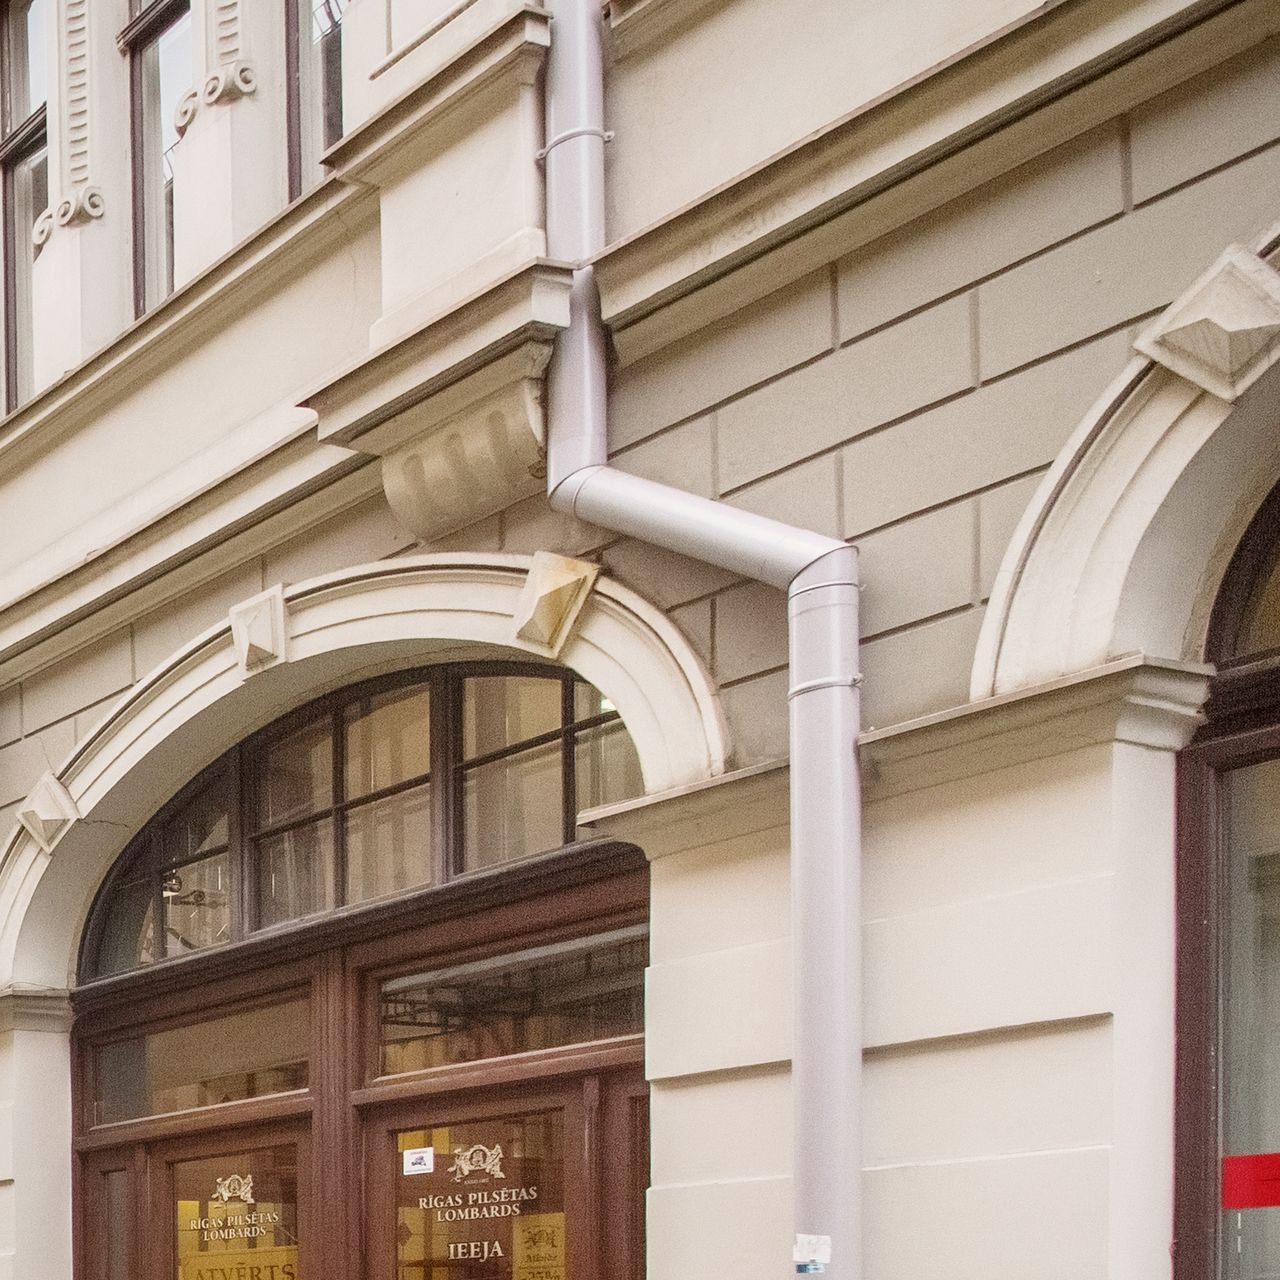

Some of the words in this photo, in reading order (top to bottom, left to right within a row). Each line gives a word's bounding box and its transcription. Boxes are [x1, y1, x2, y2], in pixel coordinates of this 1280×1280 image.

[418, 1194, 463, 1209] RĪGAS
[468, 1186, 538, 1205] PILSĒTAS
[190, 1217, 227, 1230] RĪGAS
[227, 1211, 279, 1227] PILSĒTAS
[437, 1203, 521, 1222] LOMBARDS
[203, 1226, 266, 1241] LOMBARDS
[448, 1240, 504, 1263] IEEJA
